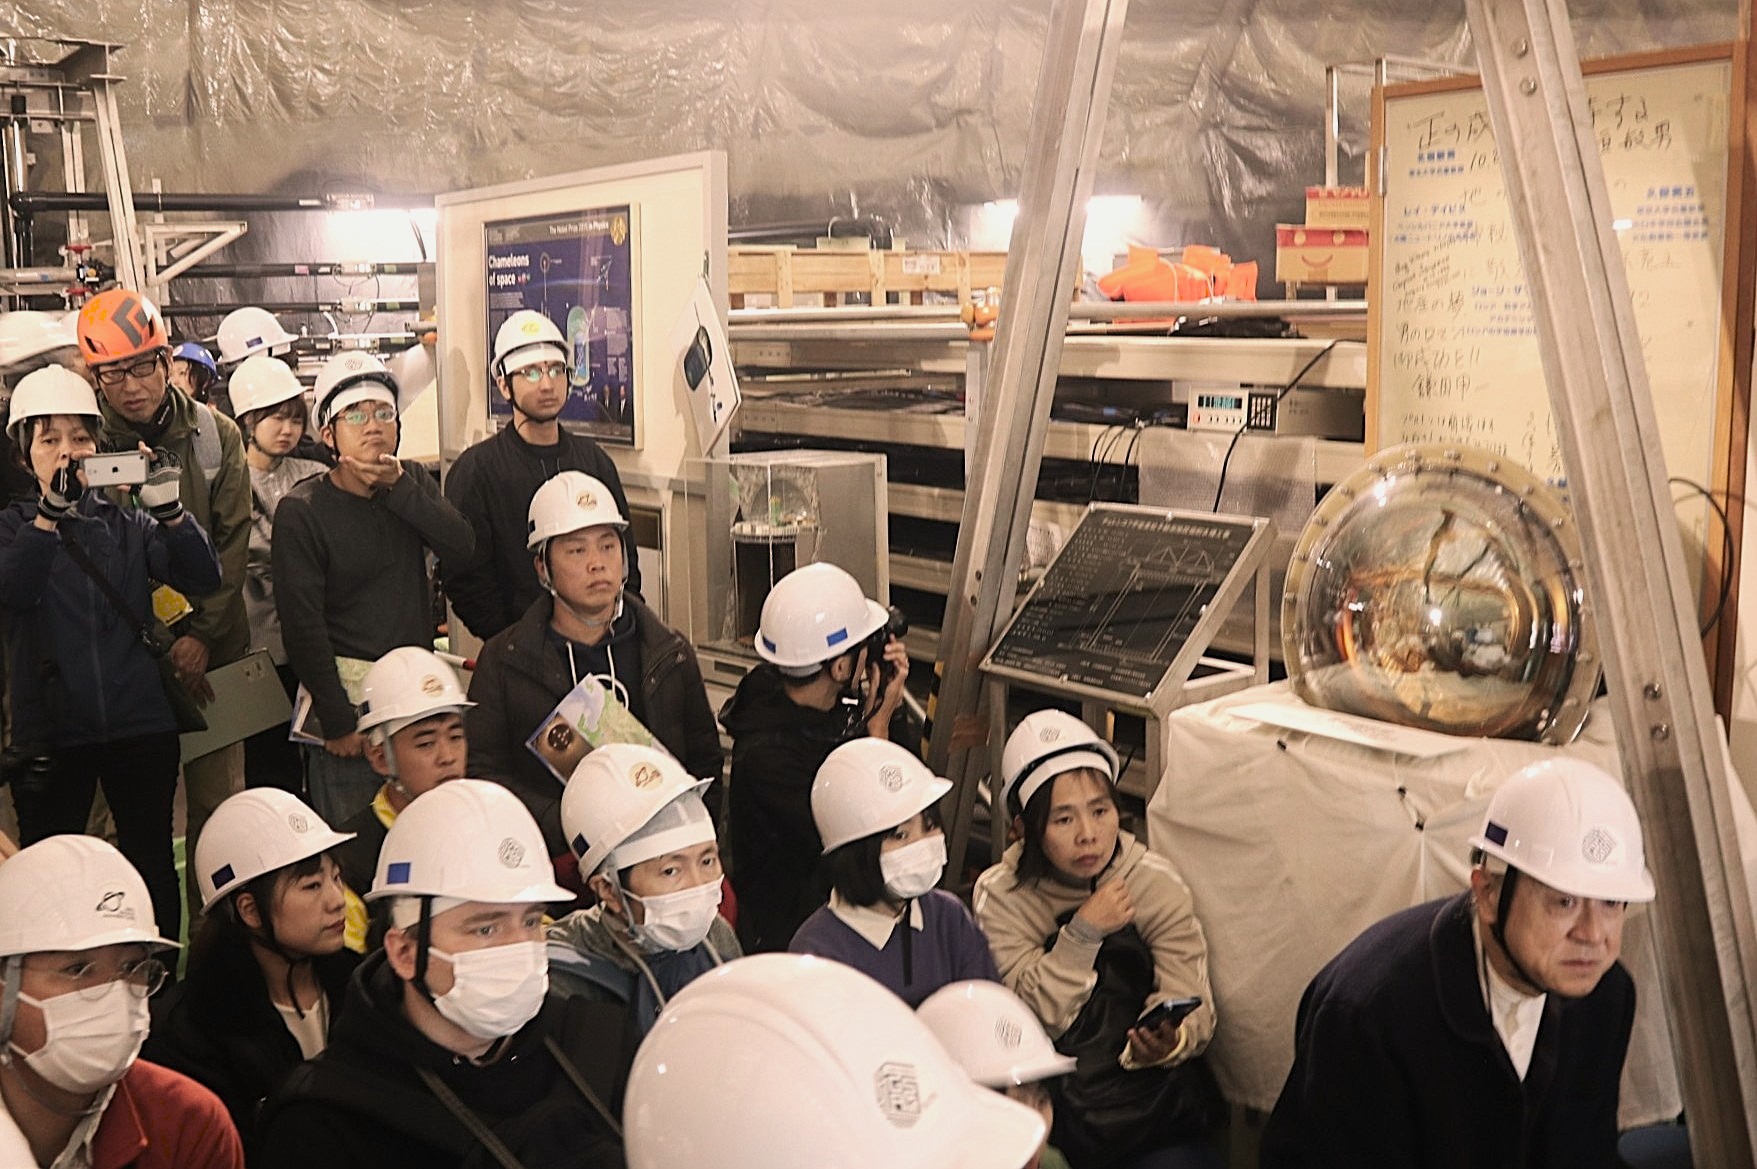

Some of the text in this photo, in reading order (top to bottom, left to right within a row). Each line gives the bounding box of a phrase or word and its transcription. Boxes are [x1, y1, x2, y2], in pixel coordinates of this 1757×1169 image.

[593, 221, 609, 231] Physics
[489, 253, 529, 269] Chameleons
[489, 272, 516, 289] of space
